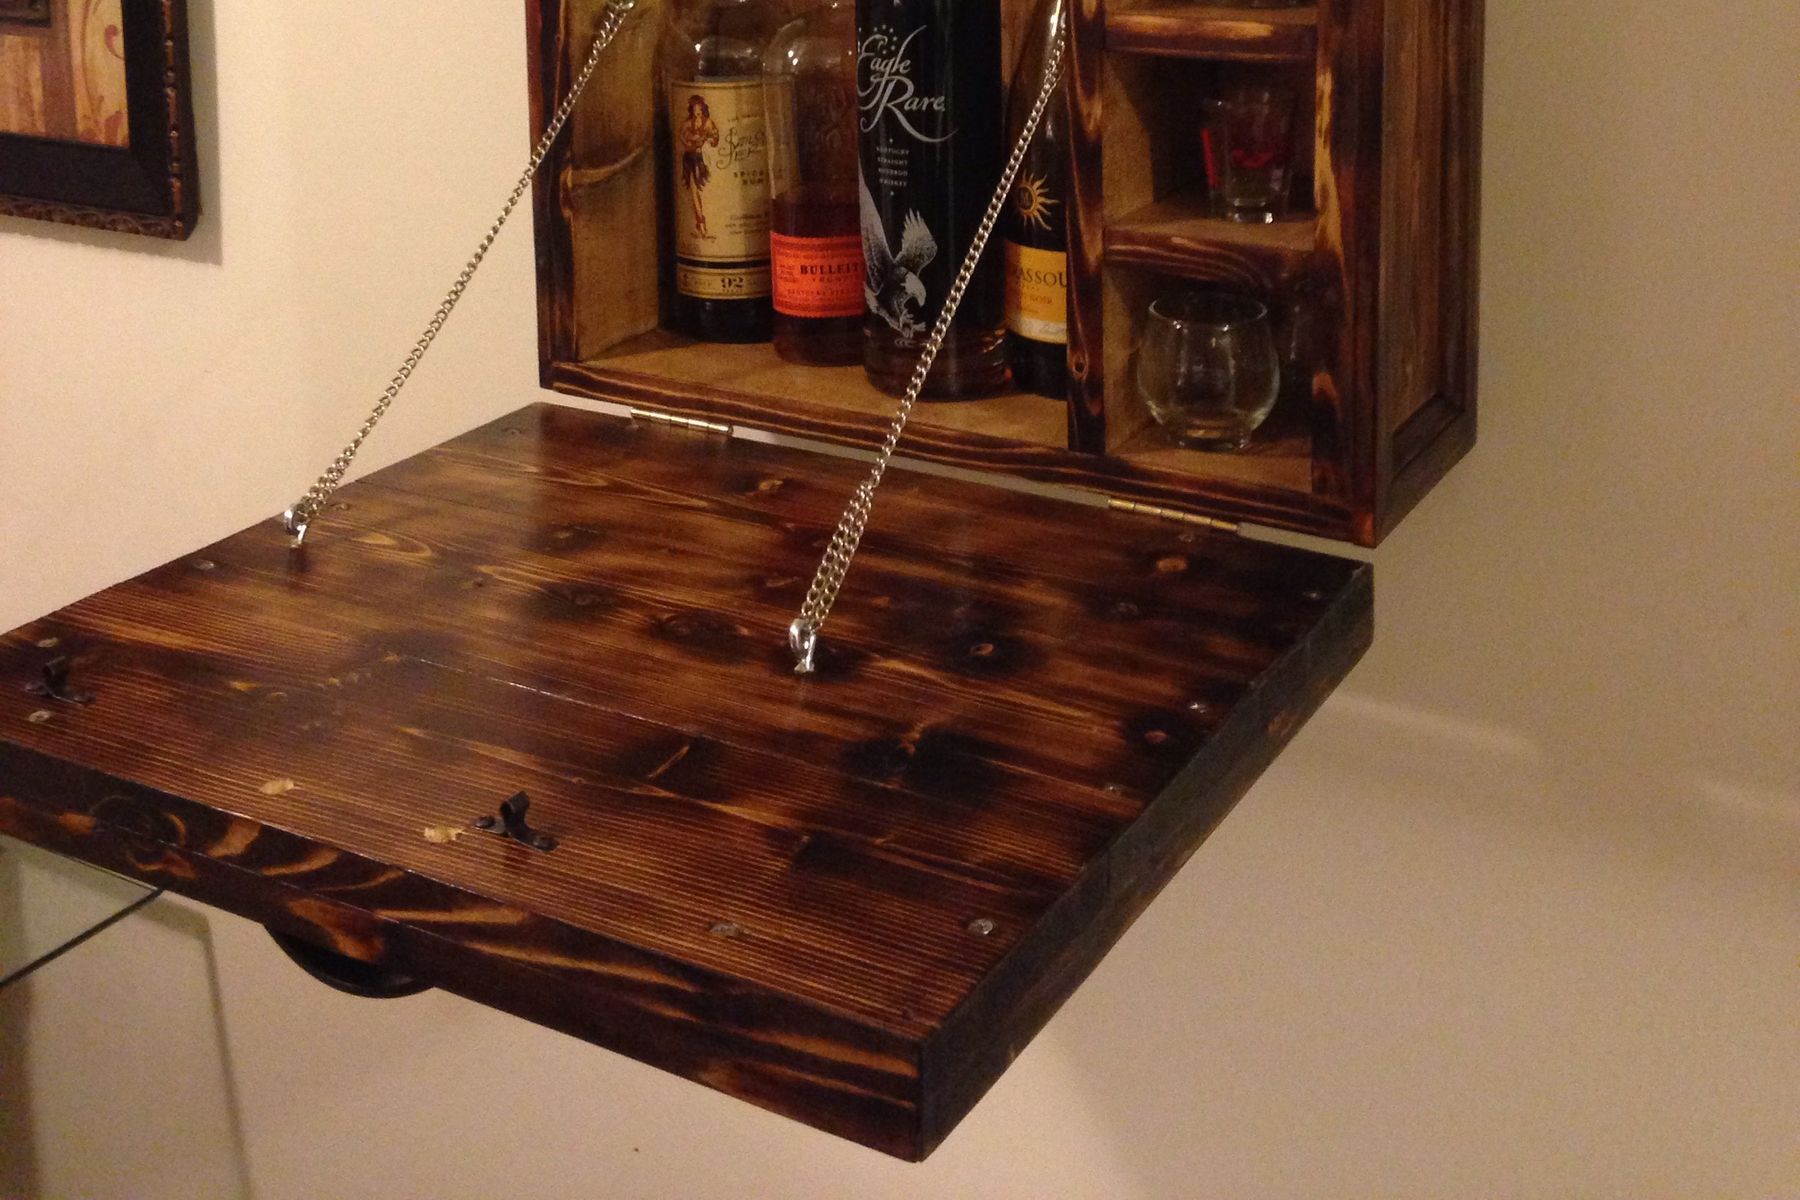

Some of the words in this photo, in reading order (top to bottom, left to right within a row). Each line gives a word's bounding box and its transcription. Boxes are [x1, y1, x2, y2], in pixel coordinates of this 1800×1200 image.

[857, 24, 927, 111] Eagle
[860, 75, 958, 142] Rare
[720, 276, 744, 288] 92
[800, 263, 859, 276] BULLEIT
